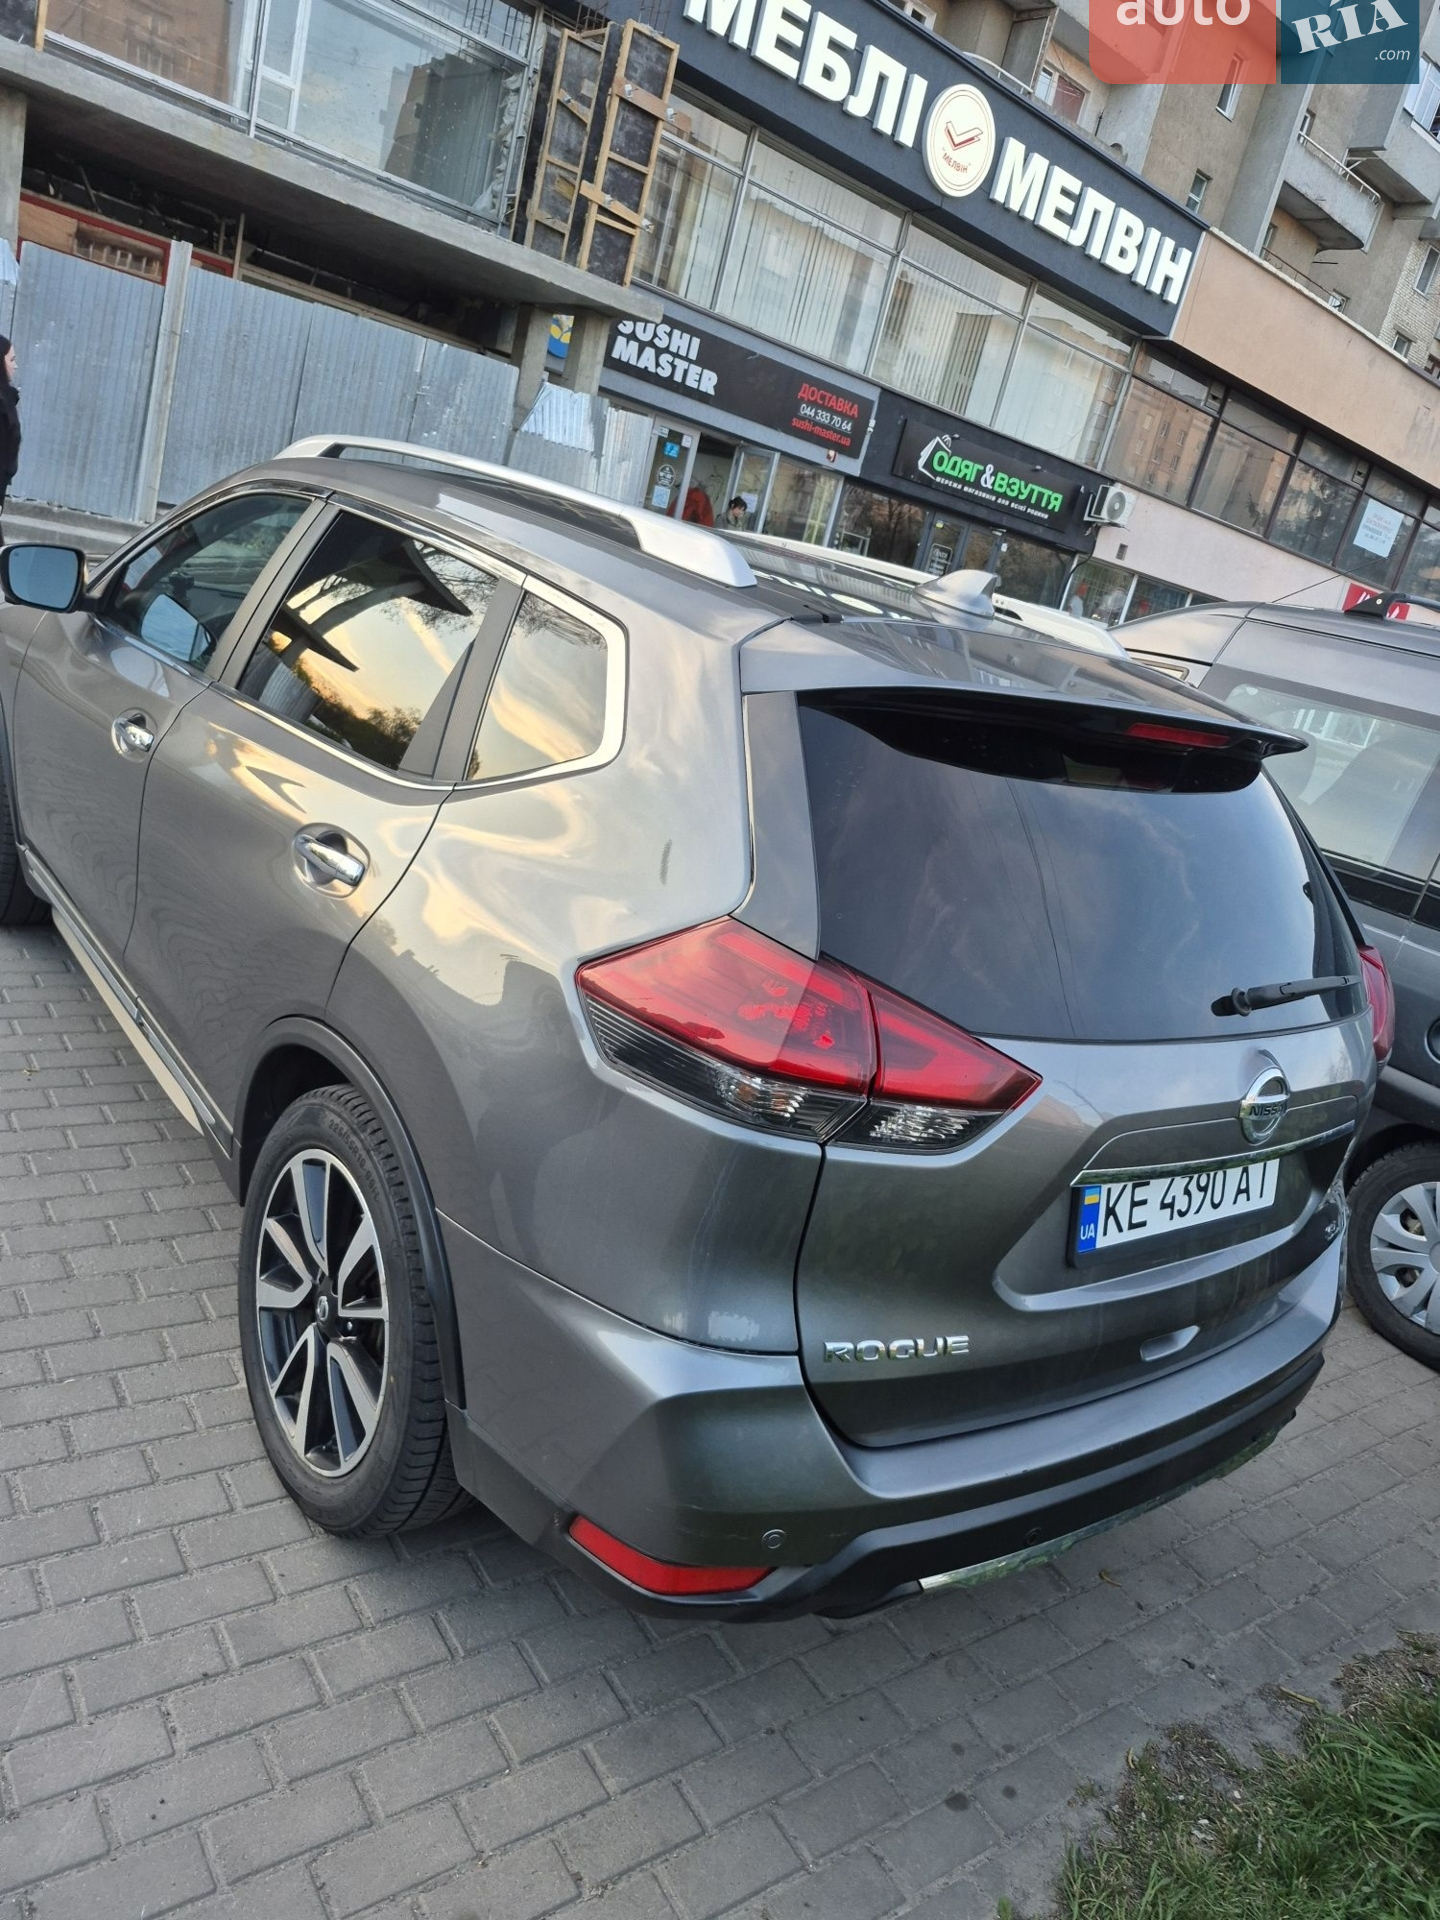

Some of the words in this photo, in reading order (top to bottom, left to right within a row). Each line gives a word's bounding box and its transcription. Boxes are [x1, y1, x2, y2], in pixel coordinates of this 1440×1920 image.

[682, 0, 929, 149] МЕБЛІ
[989, 136, 1193, 305] МЕЛВІН
[617, 320, 701, 361] SUSHI
[611, 335, 718, 396] MASTER
[797, 383, 859, 418] ДОСТАВКА
[800, 404, 815, 418] 044
[815, 409, 831, 423] 333
[830, 415, 842, 428] 70
[841, 420, 853, 432] 64
[791, 418, 851, 446] sushi-master.ua
[935, 476, 962, 490] МЕРЕЖА
[1103, 1181, 1151, 1237] KE
[1159, 1170, 1228, 1221] 4390
[1080, 1223, 1096, 1240] UA
[824, 1335, 970, 1362] ROGUE
